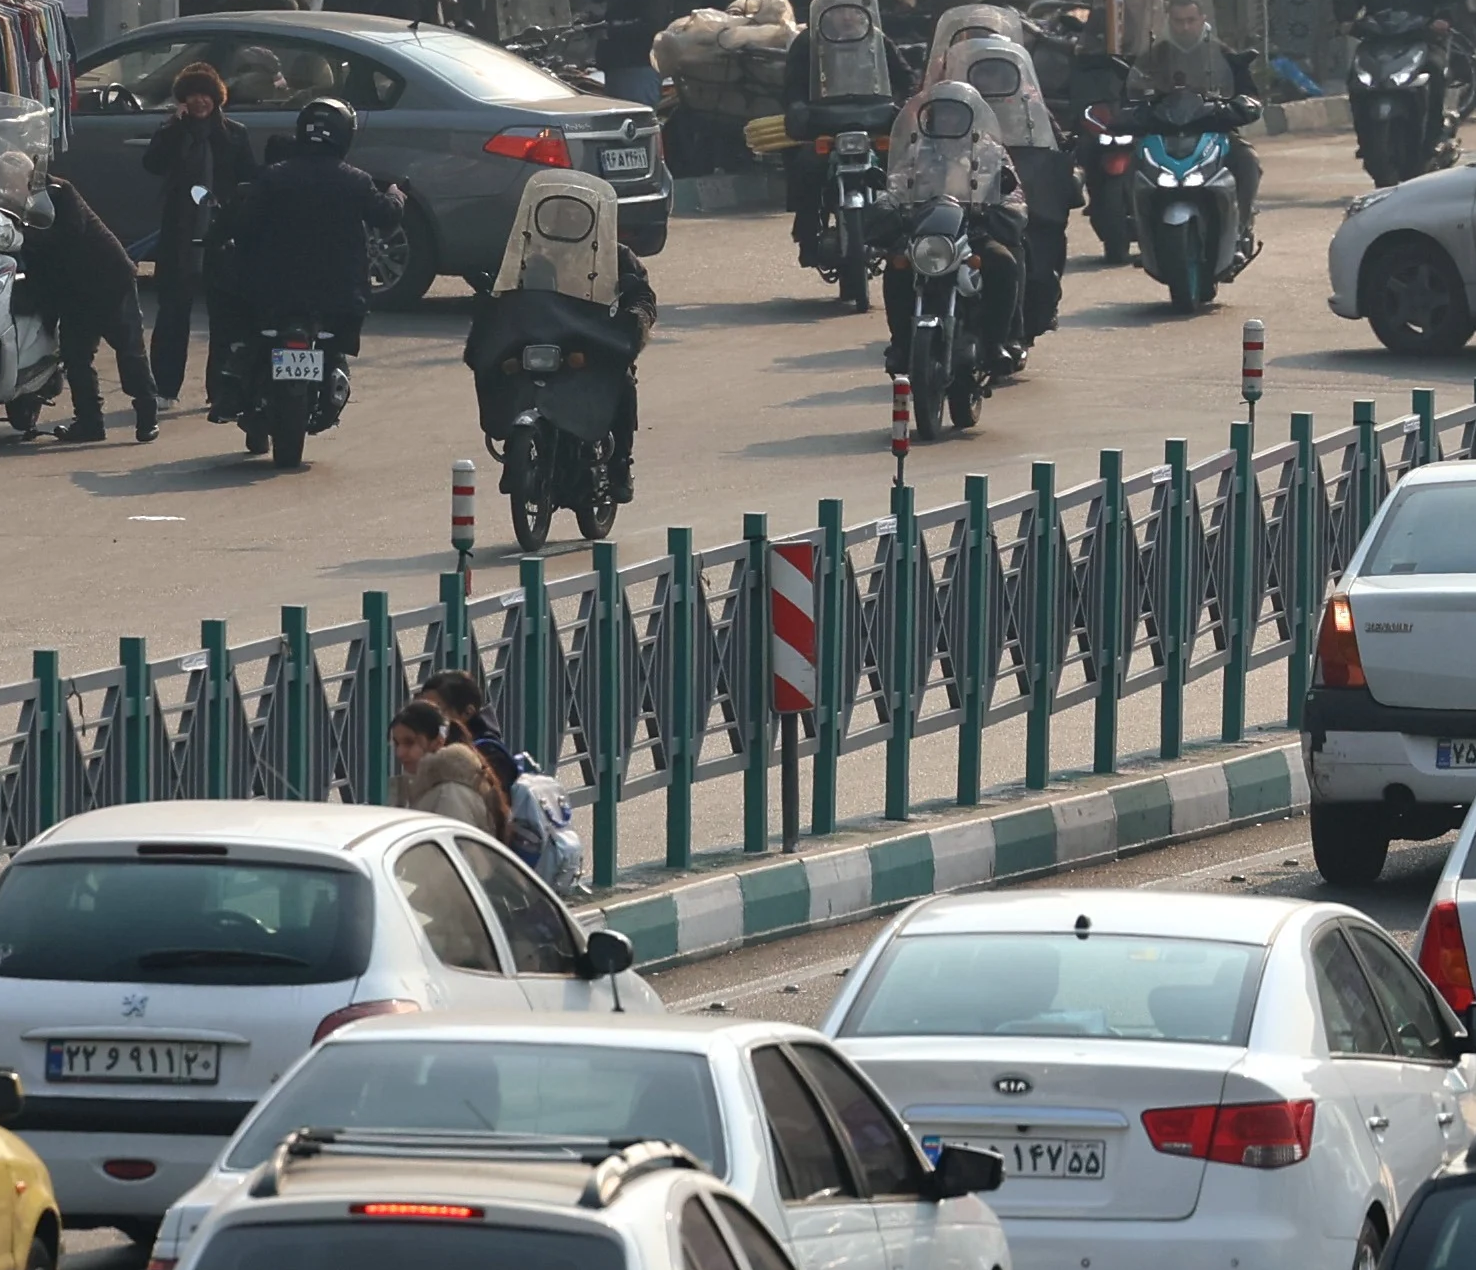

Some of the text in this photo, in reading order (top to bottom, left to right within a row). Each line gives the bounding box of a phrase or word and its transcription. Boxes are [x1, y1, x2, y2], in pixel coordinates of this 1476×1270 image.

[291, 352, 314, 363] ۱۶۱
[275, 366, 320, 378] ۶۹۵۶۶
[998, 1079, 1028, 1092] KIA
[1068, 1151, 1100, 1174] ۵۵
